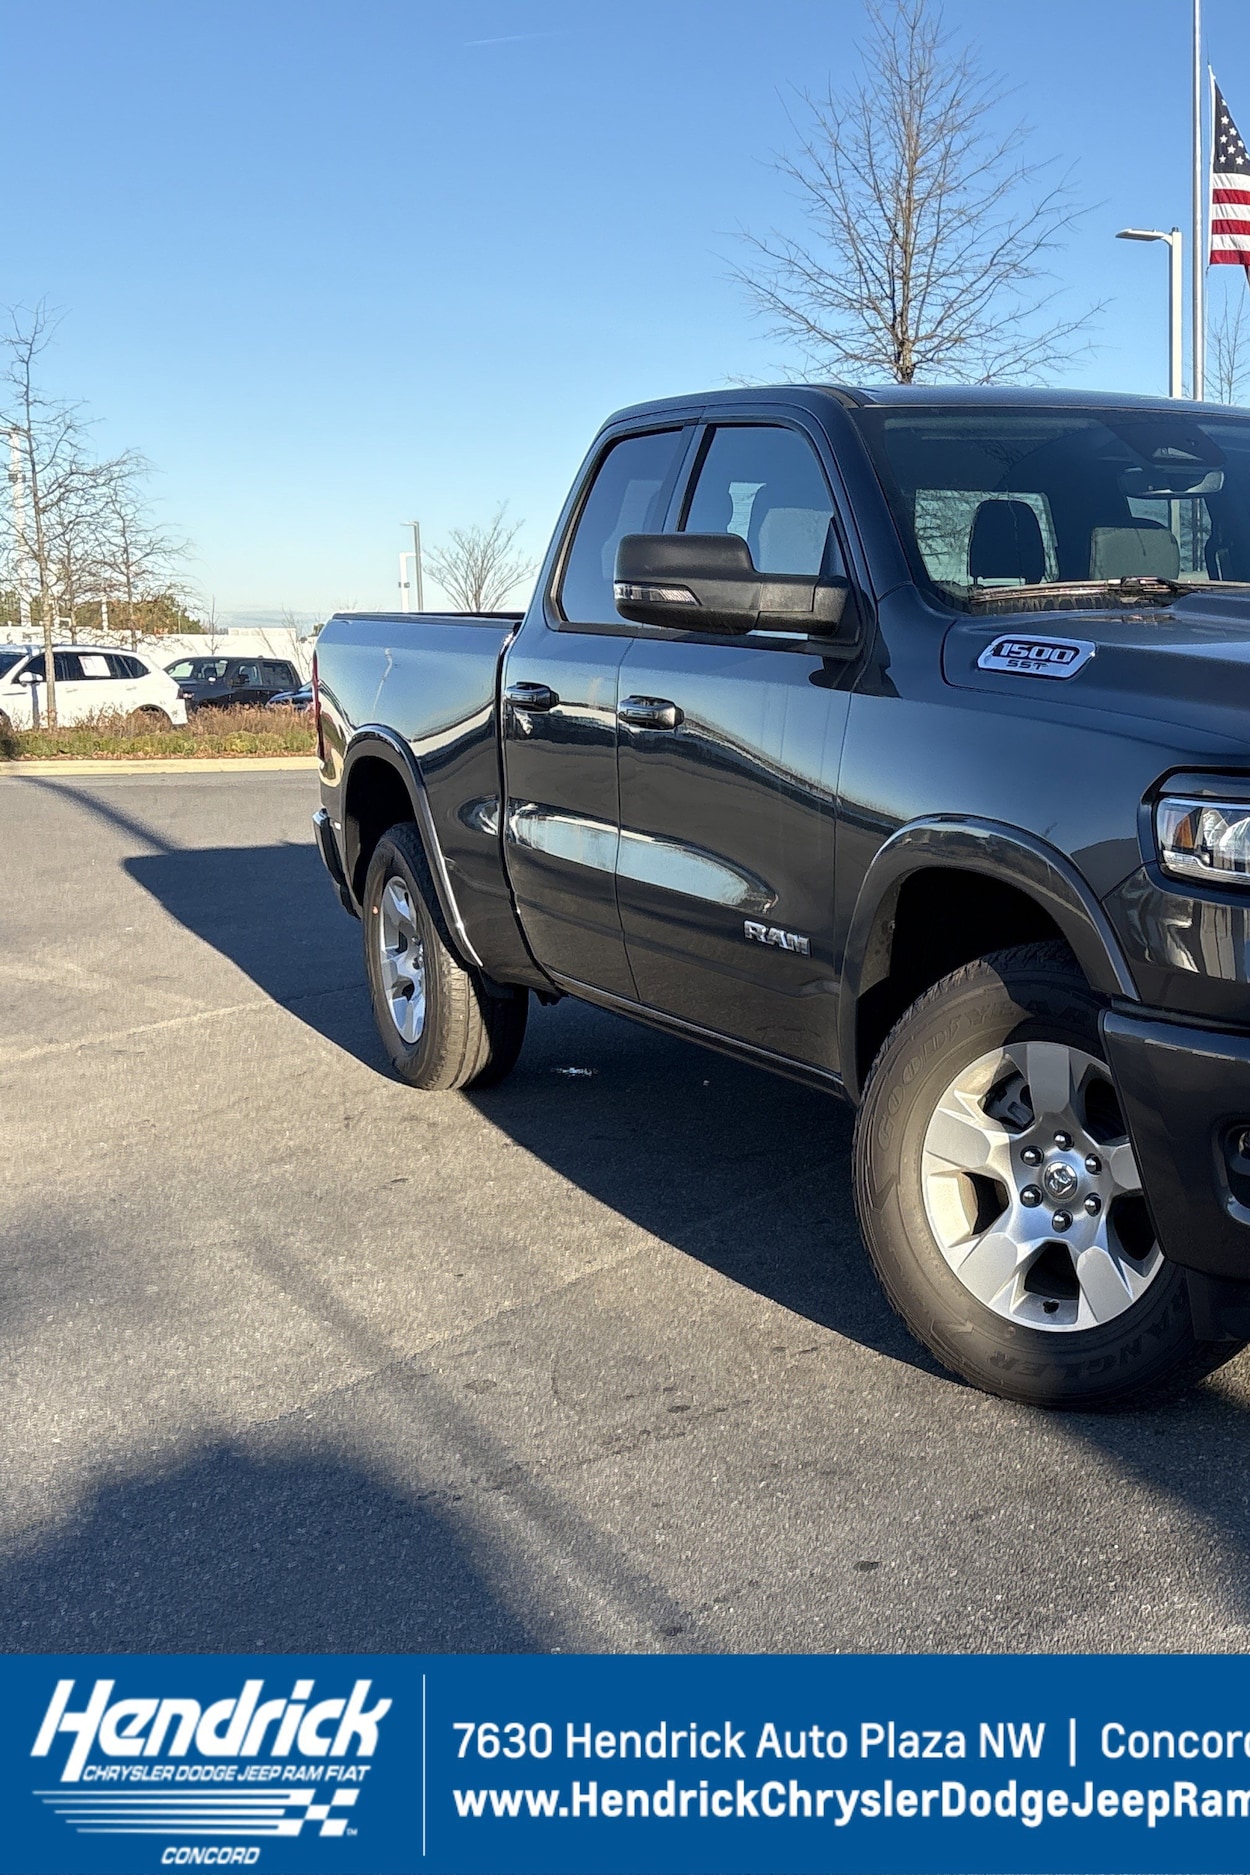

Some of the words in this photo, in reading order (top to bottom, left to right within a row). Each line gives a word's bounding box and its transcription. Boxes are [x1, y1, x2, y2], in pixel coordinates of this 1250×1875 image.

[1000, 642, 1074, 663] 1500
[744, 919, 811, 956] RAM
[877, 999, 1092, 1152] GOODYEAR
